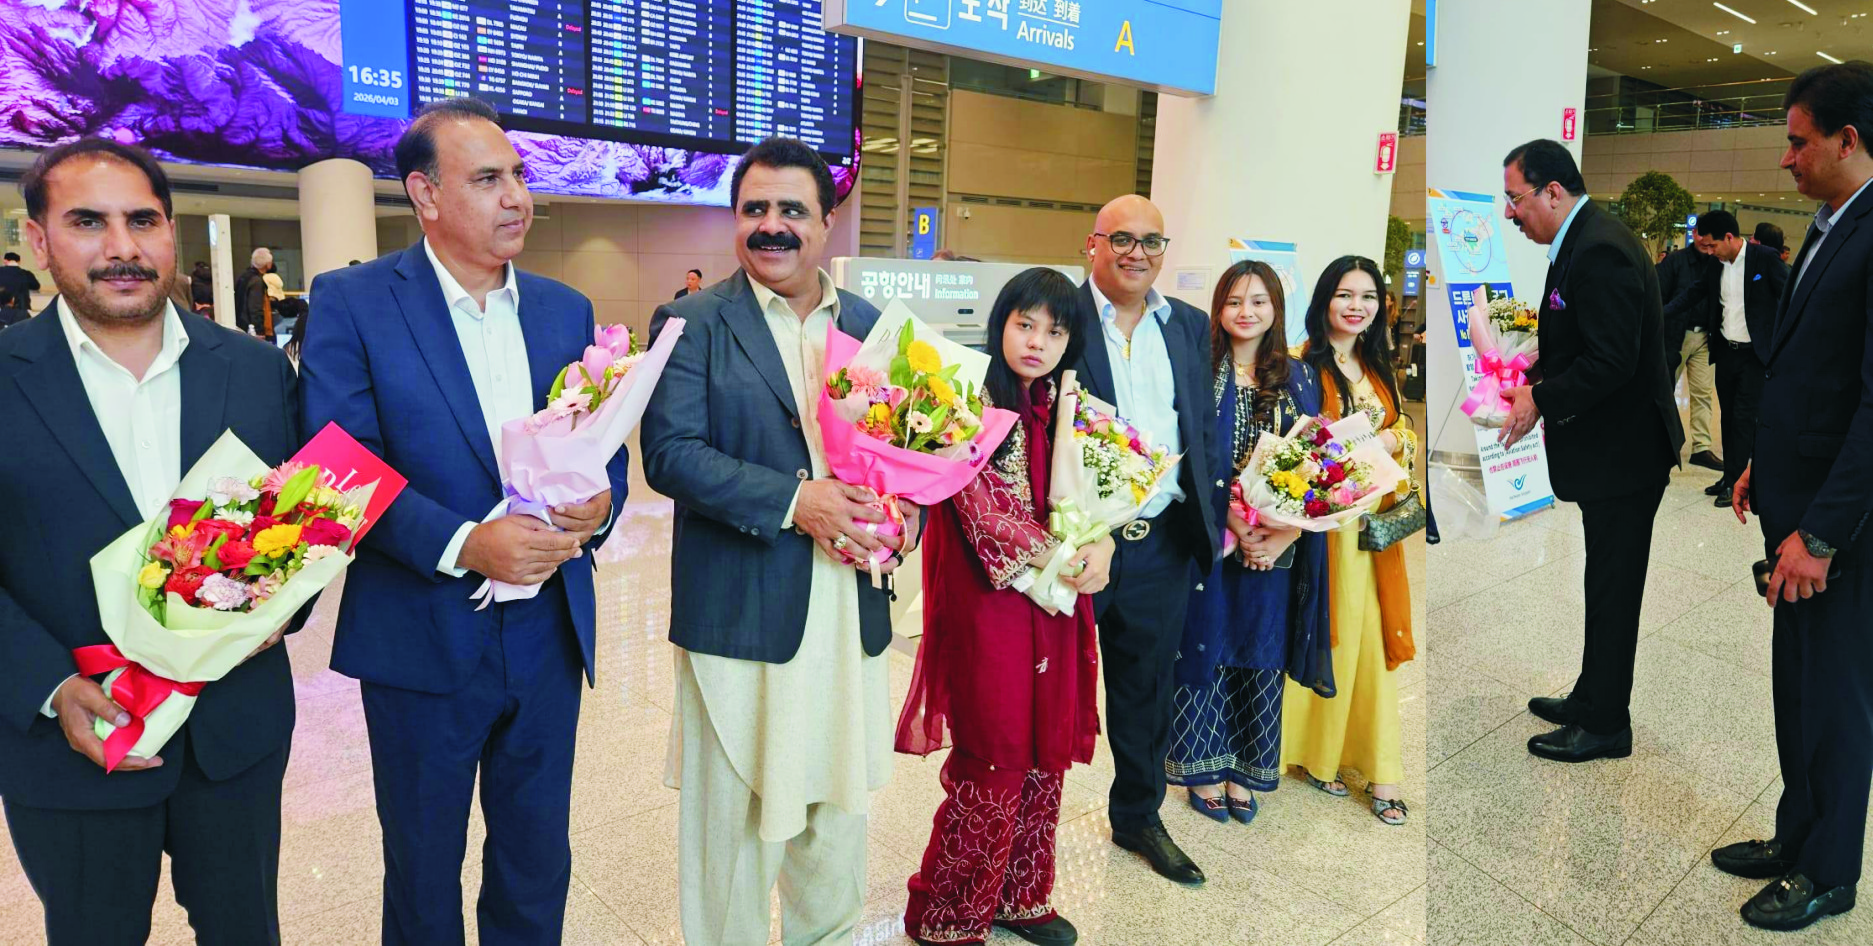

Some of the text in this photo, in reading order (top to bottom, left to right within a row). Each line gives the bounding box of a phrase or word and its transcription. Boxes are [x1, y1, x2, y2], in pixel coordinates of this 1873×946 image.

[1016, 20, 1075, 51] Arrivals
[1115, 20, 1135, 56] A
[349, 65, 403, 89] 16:35
[353, 92, 399, 106] 2026/04/03
[919, 214, 930, 235] B
[861, 271, 931, 299] 공항안내
[935, 287, 979, 300] Information
